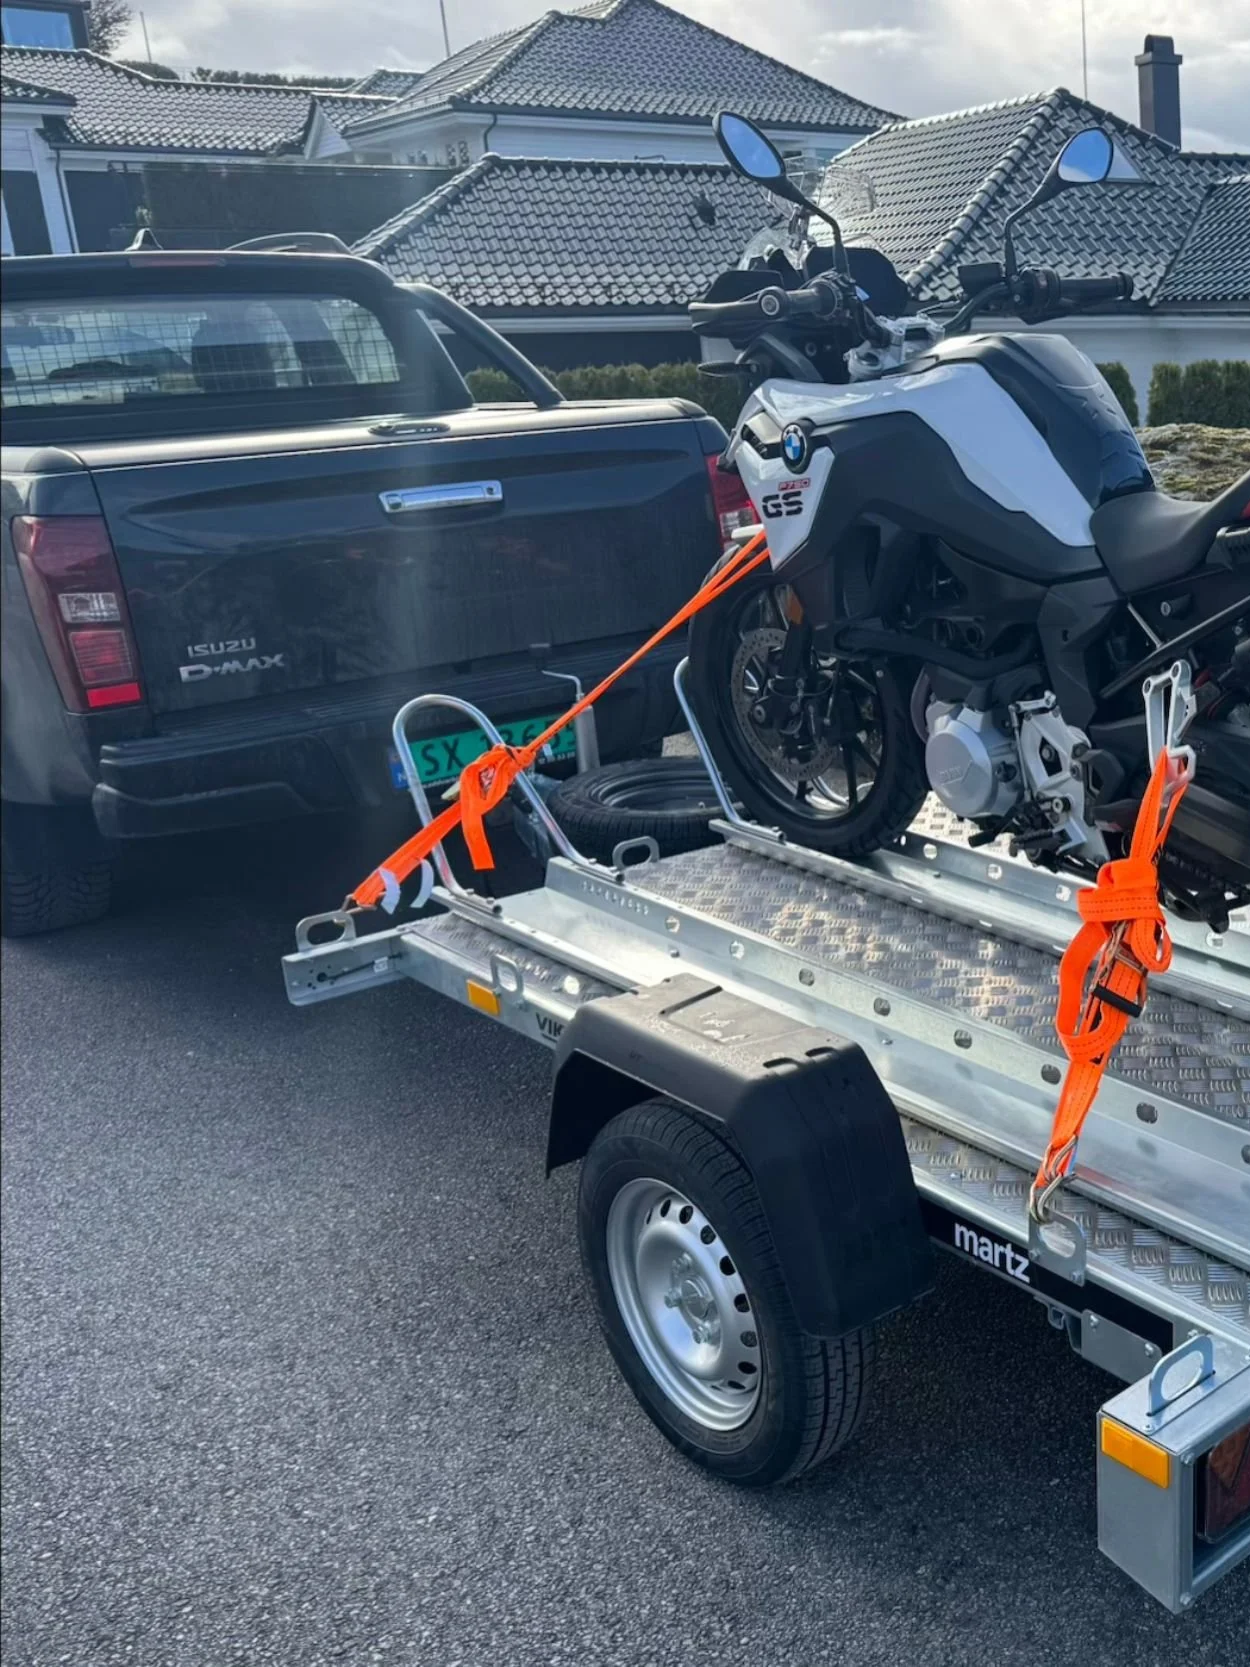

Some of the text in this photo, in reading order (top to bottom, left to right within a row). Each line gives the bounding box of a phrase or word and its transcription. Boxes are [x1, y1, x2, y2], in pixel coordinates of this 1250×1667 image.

[762, 491, 803, 518] GS
[187, 637, 256, 659] ISUZU
[420, 737, 465, 776] SX
[955, 1222, 1030, 1284] martz
